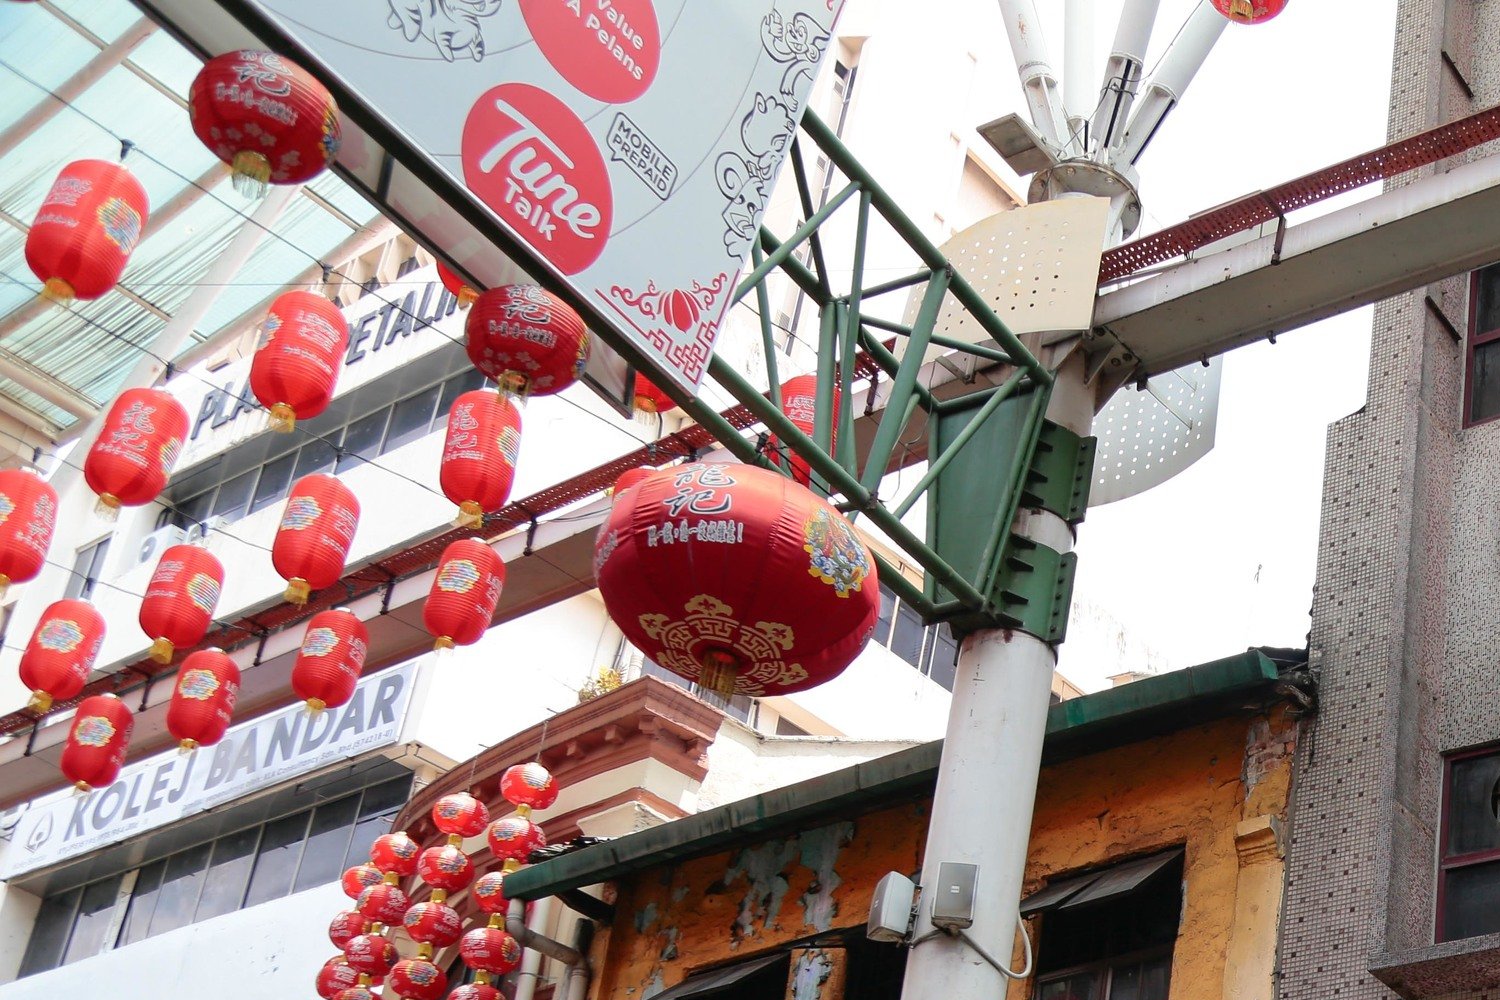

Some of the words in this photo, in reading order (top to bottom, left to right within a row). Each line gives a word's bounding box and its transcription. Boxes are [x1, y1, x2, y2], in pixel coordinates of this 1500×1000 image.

[586, 13, 644, 80] Pelans
[597, 0, 644, 50] Value
[480, 99, 601, 239] Tune
[612, 134, 668, 196] PREPAID
[618, 119, 673, 179] MOBILE
[503, 178, 556, 242] Talk
[63, 751, 198, 843] KOLEJ
[202, 673, 406, 792] BANDAR
